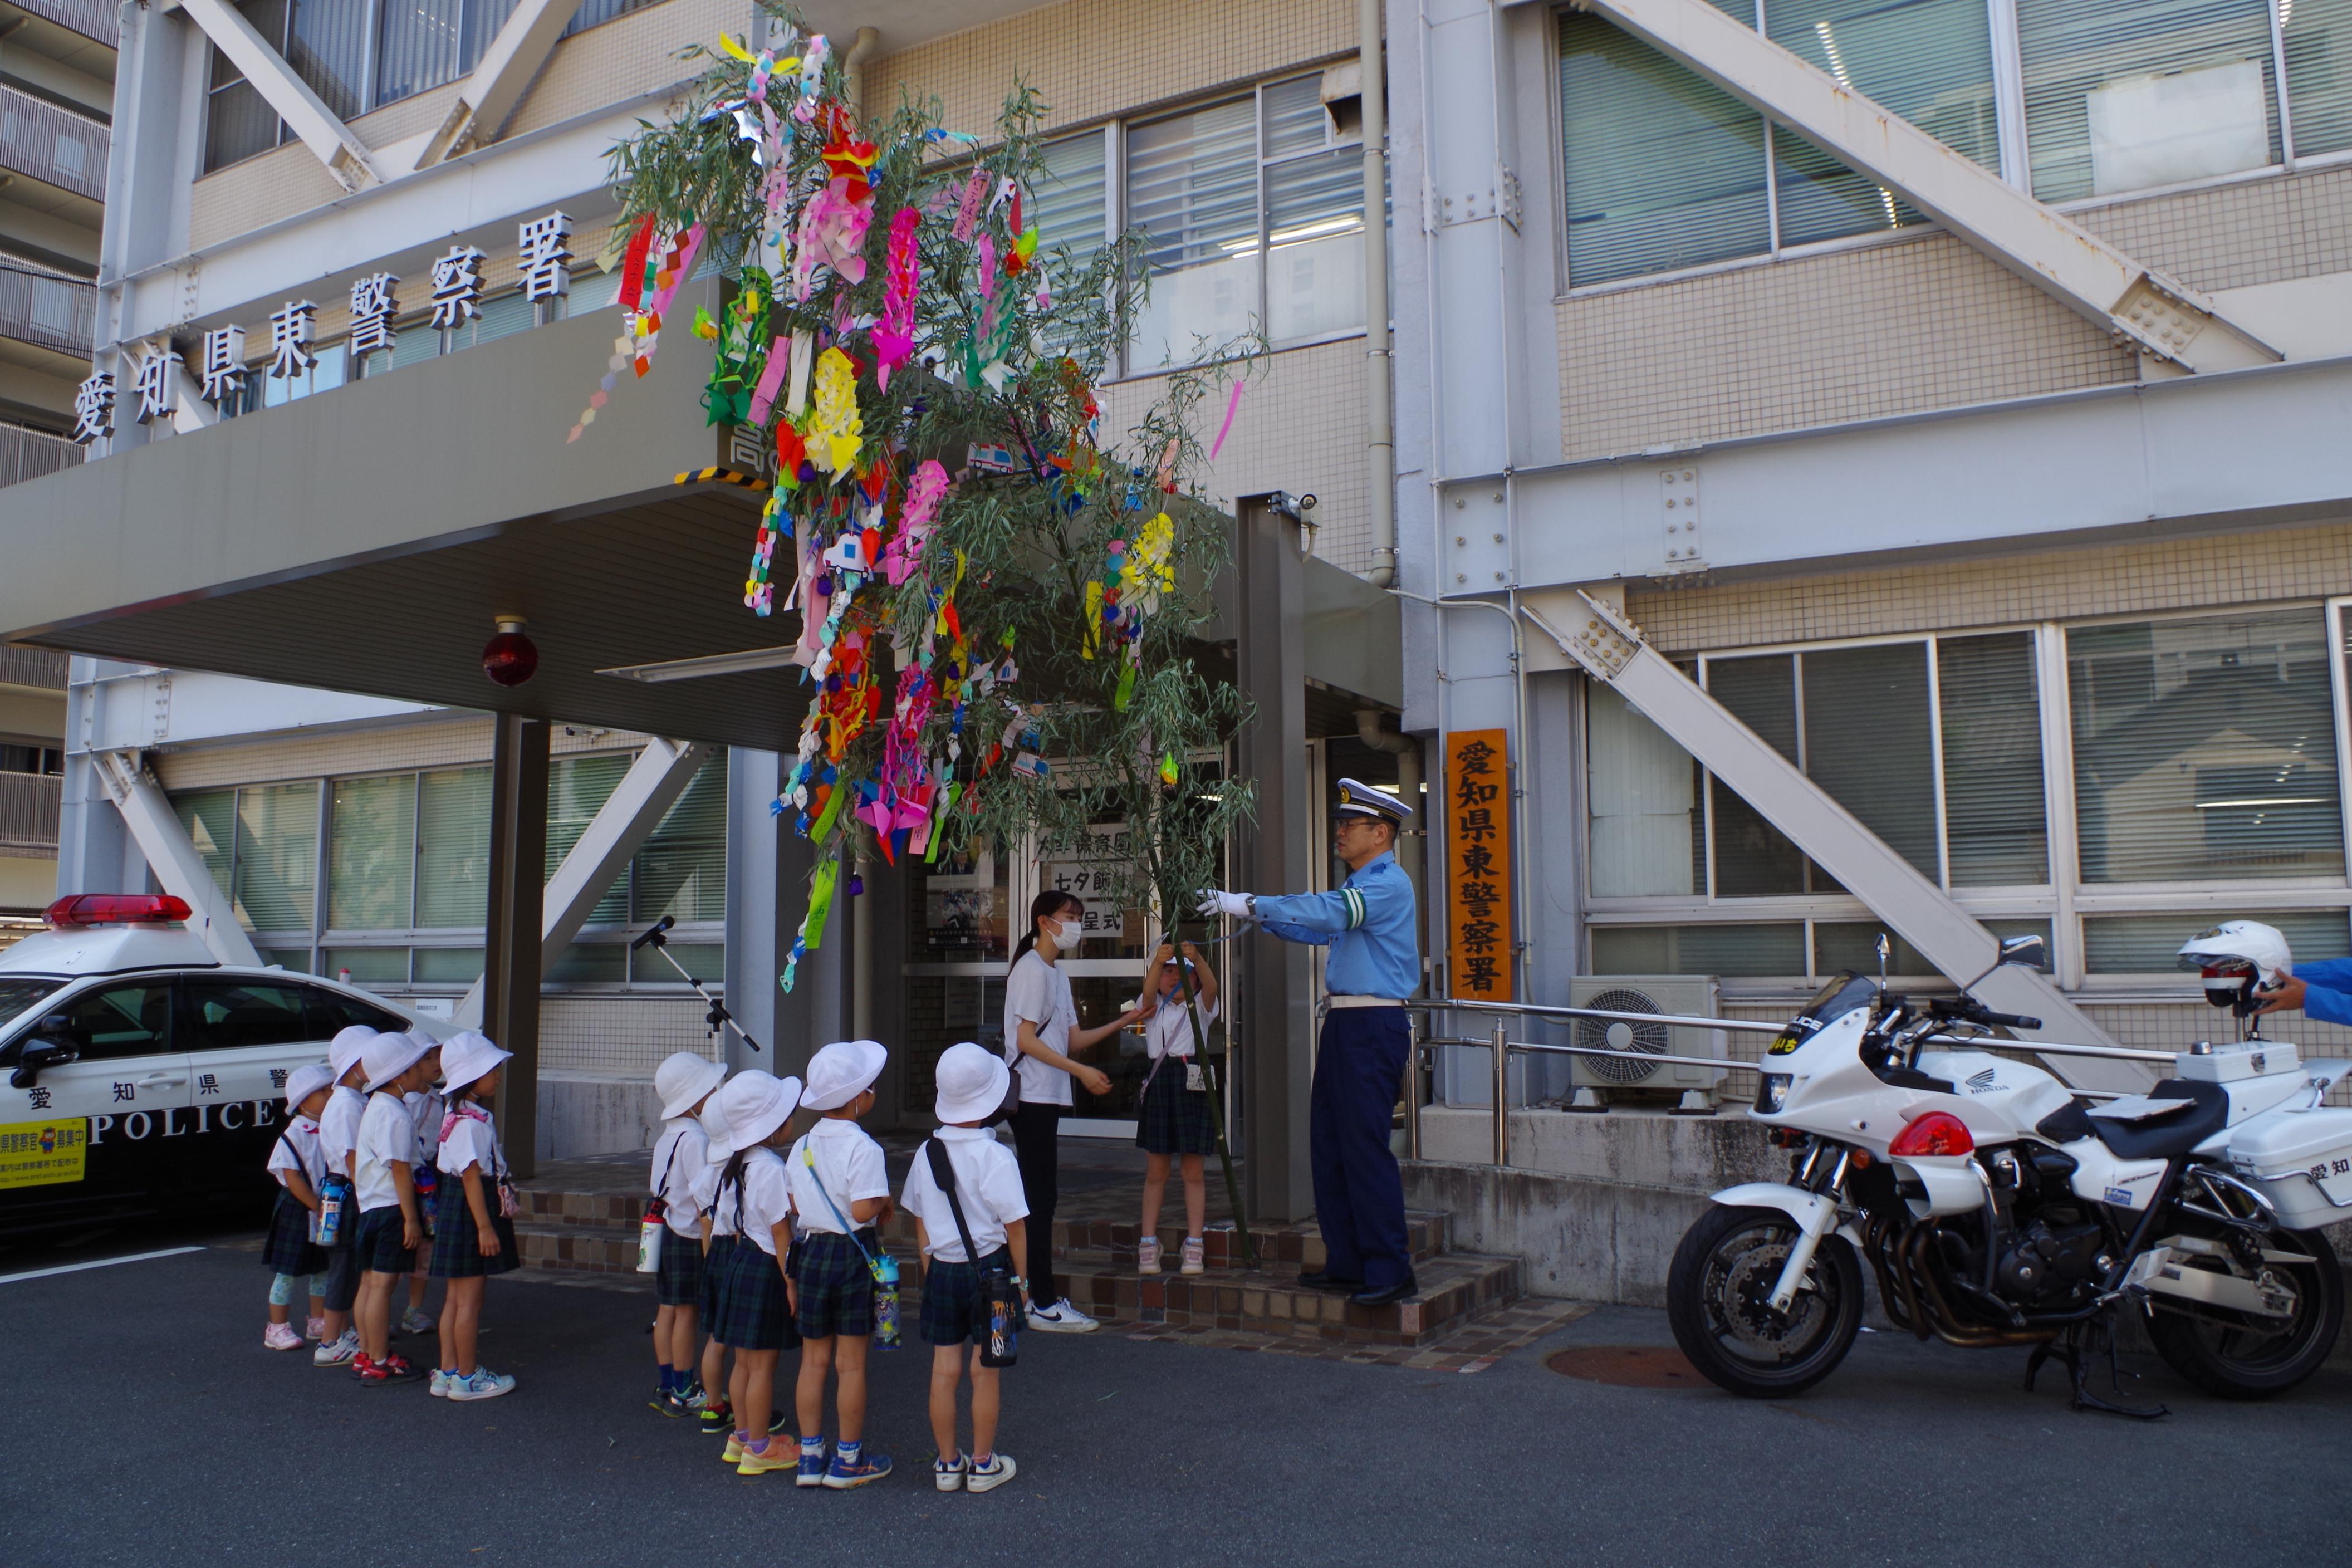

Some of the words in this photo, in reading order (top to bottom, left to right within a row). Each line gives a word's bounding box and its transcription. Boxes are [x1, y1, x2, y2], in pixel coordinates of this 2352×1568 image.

[74, 210, 573, 445] 愛知県東警察署
[1456, 740, 1502, 993] 愛知県東警察署
[28, 1068, 288, 1110] 愛知県警
[1970, 1085, 2010, 1094] HONDA
[57, 1128, 84, 1149] 募集中
[87, 1099, 276, 1145] POLICE
